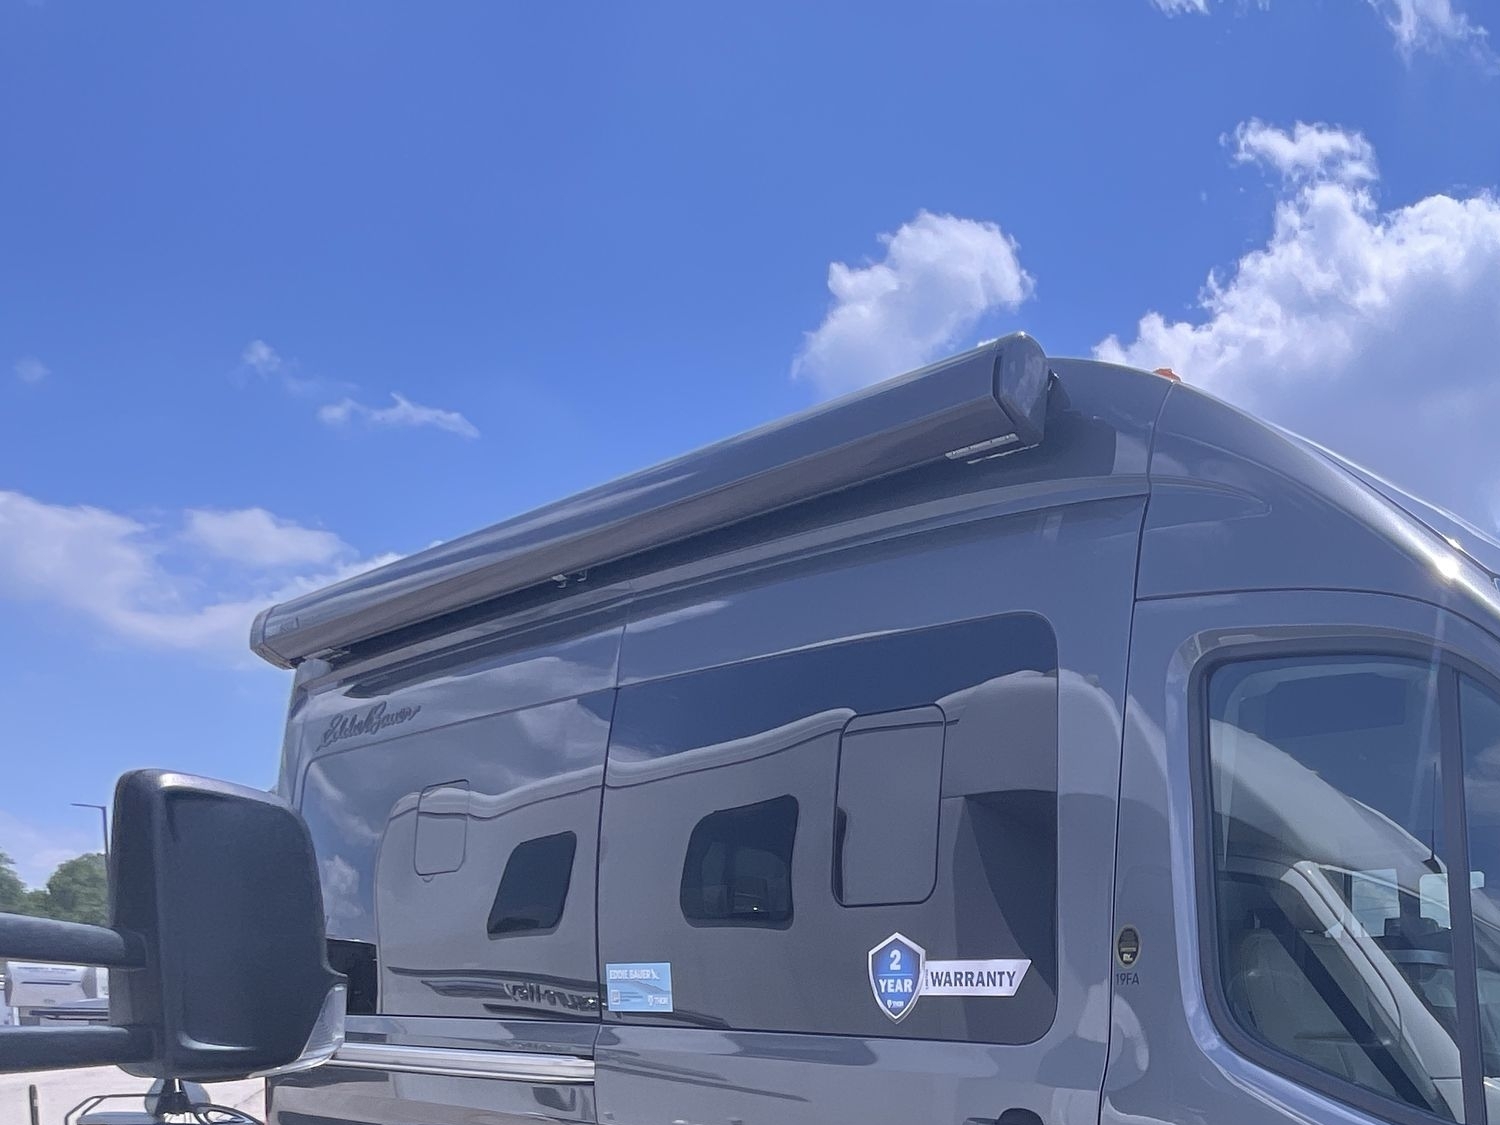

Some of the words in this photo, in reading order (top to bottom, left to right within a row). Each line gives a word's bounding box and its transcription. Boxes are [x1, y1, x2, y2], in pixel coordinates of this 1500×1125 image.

[889, 949, 901, 971] 2
[878, 978, 913, 993] YEAR
[930, 970, 1017, 988] WARRANTY
[1115, 973, 1140, 985] 19FA
